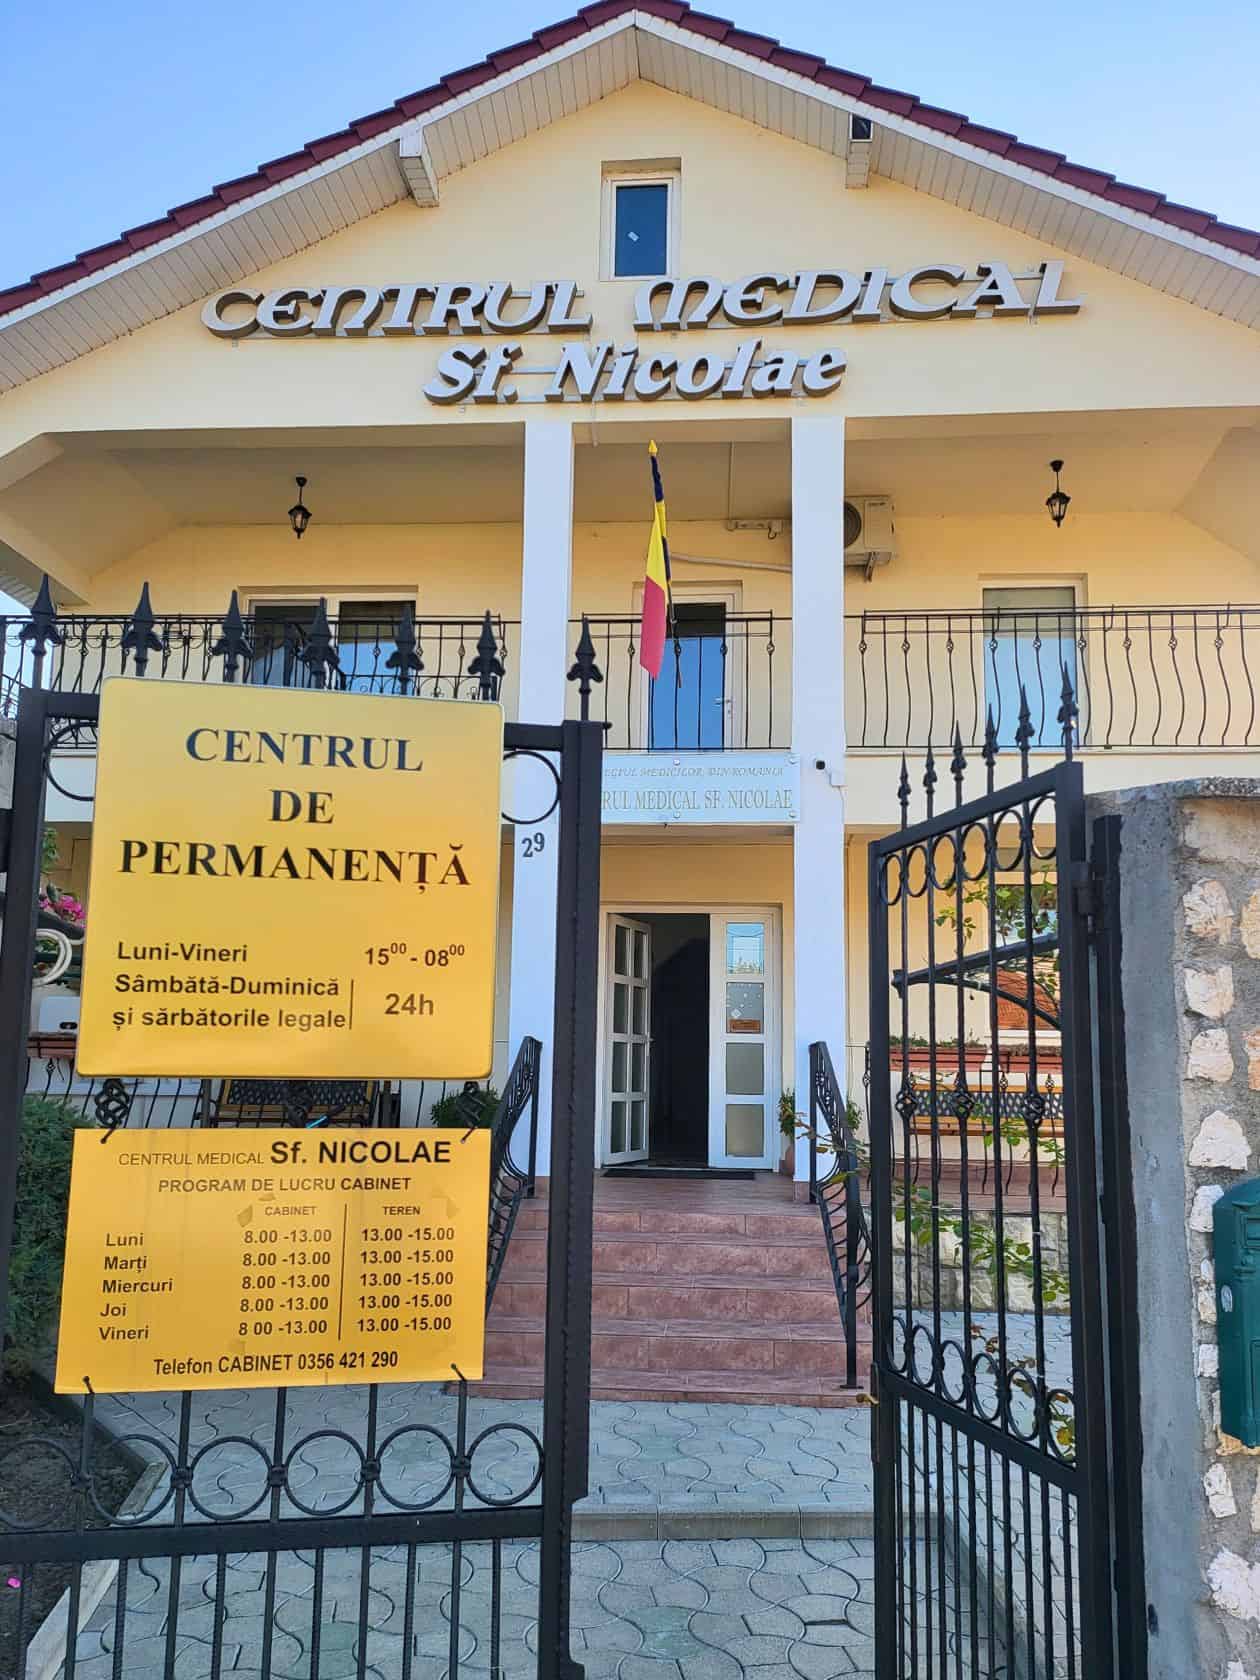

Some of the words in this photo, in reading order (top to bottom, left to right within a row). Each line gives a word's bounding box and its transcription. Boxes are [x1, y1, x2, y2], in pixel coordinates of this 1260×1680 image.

[201, 281, 592, 338] CENTRUL
[634, 260, 1081, 331] MEDICAL
[423, 342, 523, 405] Sf.
[545, 338, 847, 402] Nicolae
[185, 728, 424, 772] CENTRUL
[268, 789, 334, 824] DE
[636, 790, 700, 809] MEDICAL
[728, 789, 793, 809] NICOLAE
[521, 832, 545, 858] 29
[118, 840, 471, 894] PERMANENȚĂ
[117, 941, 248, 962] Luni-Vineri
[115, 974, 339, 996] Sâmbătă-Duminică
[385, 993, 434, 1016] 24h
[113, 1008, 133, 1031] și
[142, 1007, 270, 1027] sărbătorile
[278, 1009, 346, 1031] legale
[118, 1153, 193, 1166] CENTRUL
[197, 1152, 265, 1165] MEDICAL
[270, 1141, 307, 1164] Sf.
[318, 1140, 451, 1163] NICOLAE
[158, 1179, 246, 1193] PROGRAM
[251, 1179, 273, 1191] DE
[279, 1179, 336, 1191] LUCRU
[340, 1177, 411, 1191] CABINET
[264, 1206, 317, 1216] CABINET
[383, 1206, 421, 1216] TEREN
[106, 1233, 144, 1247] Luni
[244, 1230, 278, 1243] 8.00
[361, 1228, 402, 1242] 13.00
[104, 1256, 147, 1273] Marți
[242, 1253, 277, 1266] 8.00
[360, 1250, 401, 1264] 13.00
[102, 1279, 173, 1294] Miercuri
[242, 1276, 276, 1289] 8.00
[360, 1273, 401, 1287] 13.00
[100, 1303, 127, 1317] Joi
[240, 1299, 274, 1312] 8.00
[358, 1295, 400, 1309] 13.00
[99, 1326, 149, 1340] Vineri
[357, 1318, 399, 1332] 13.00
[154, 1357, 212, 1375] Telefon
[218, 1354, 293, 1373] CABINET
[298, 1352, 334, 1370] 0356
[339, 1351, 366, 1368] 421
[371, 1351, 398, 1368] 290
